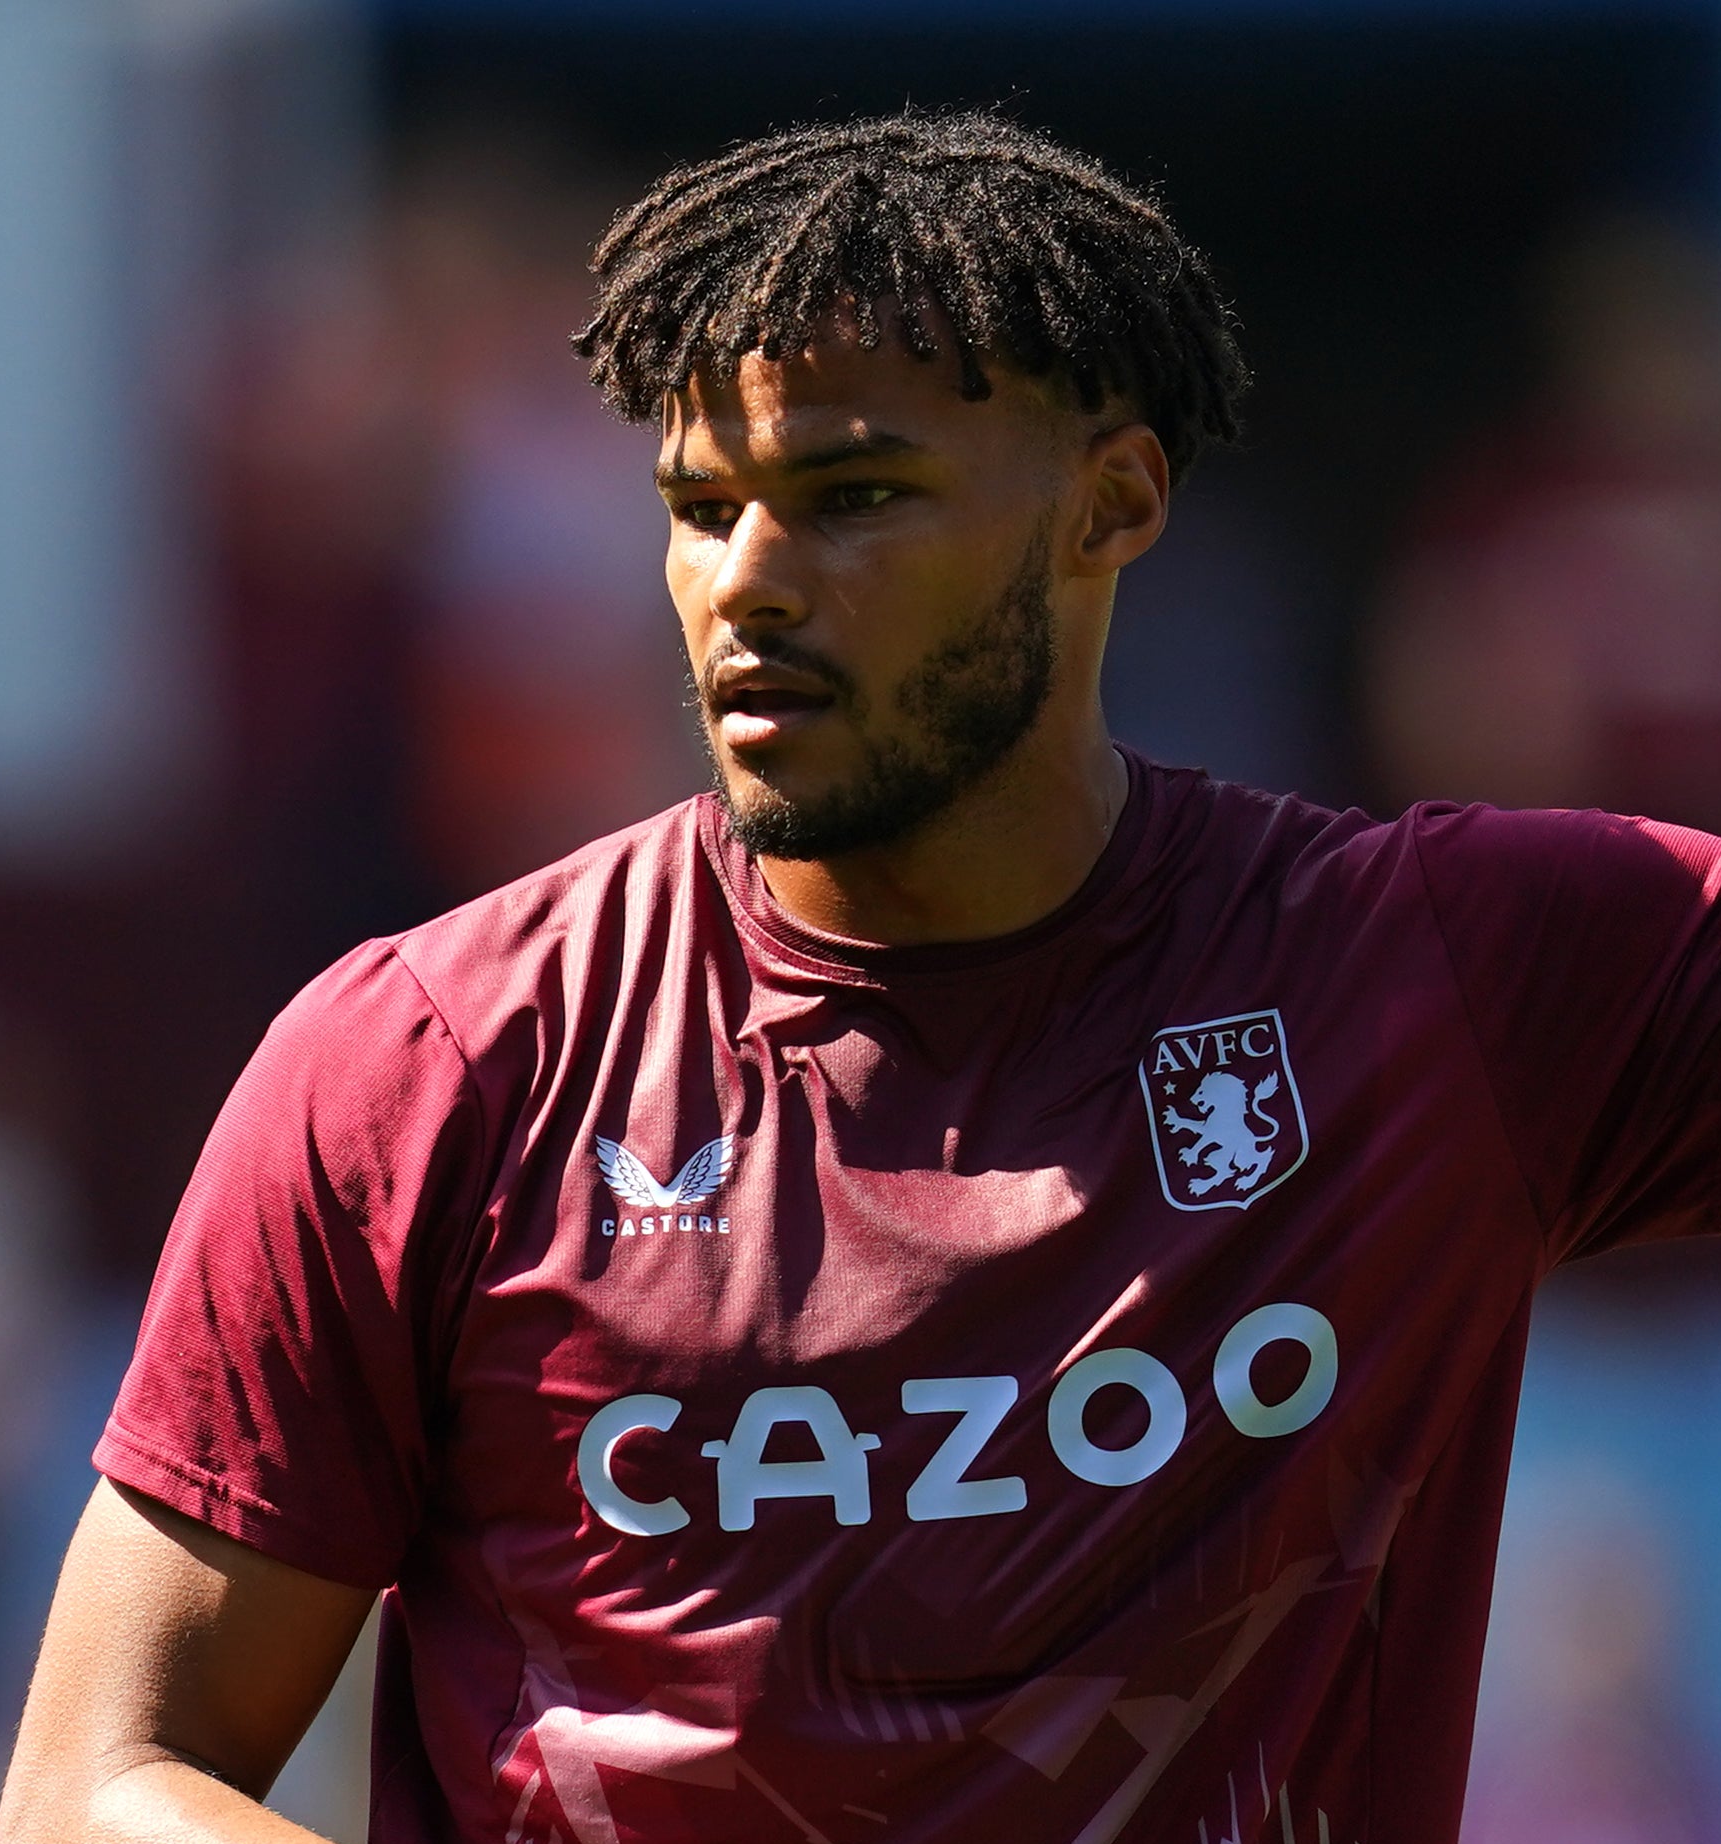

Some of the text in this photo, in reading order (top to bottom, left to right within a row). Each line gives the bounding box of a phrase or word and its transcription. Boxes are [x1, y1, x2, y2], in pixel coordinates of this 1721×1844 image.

[1152, 1023, 1276, 1078] AVFC
[601, 1214, 731, 1237] CASTORE
[577, 1302, 1339, 1537] CAZOO
